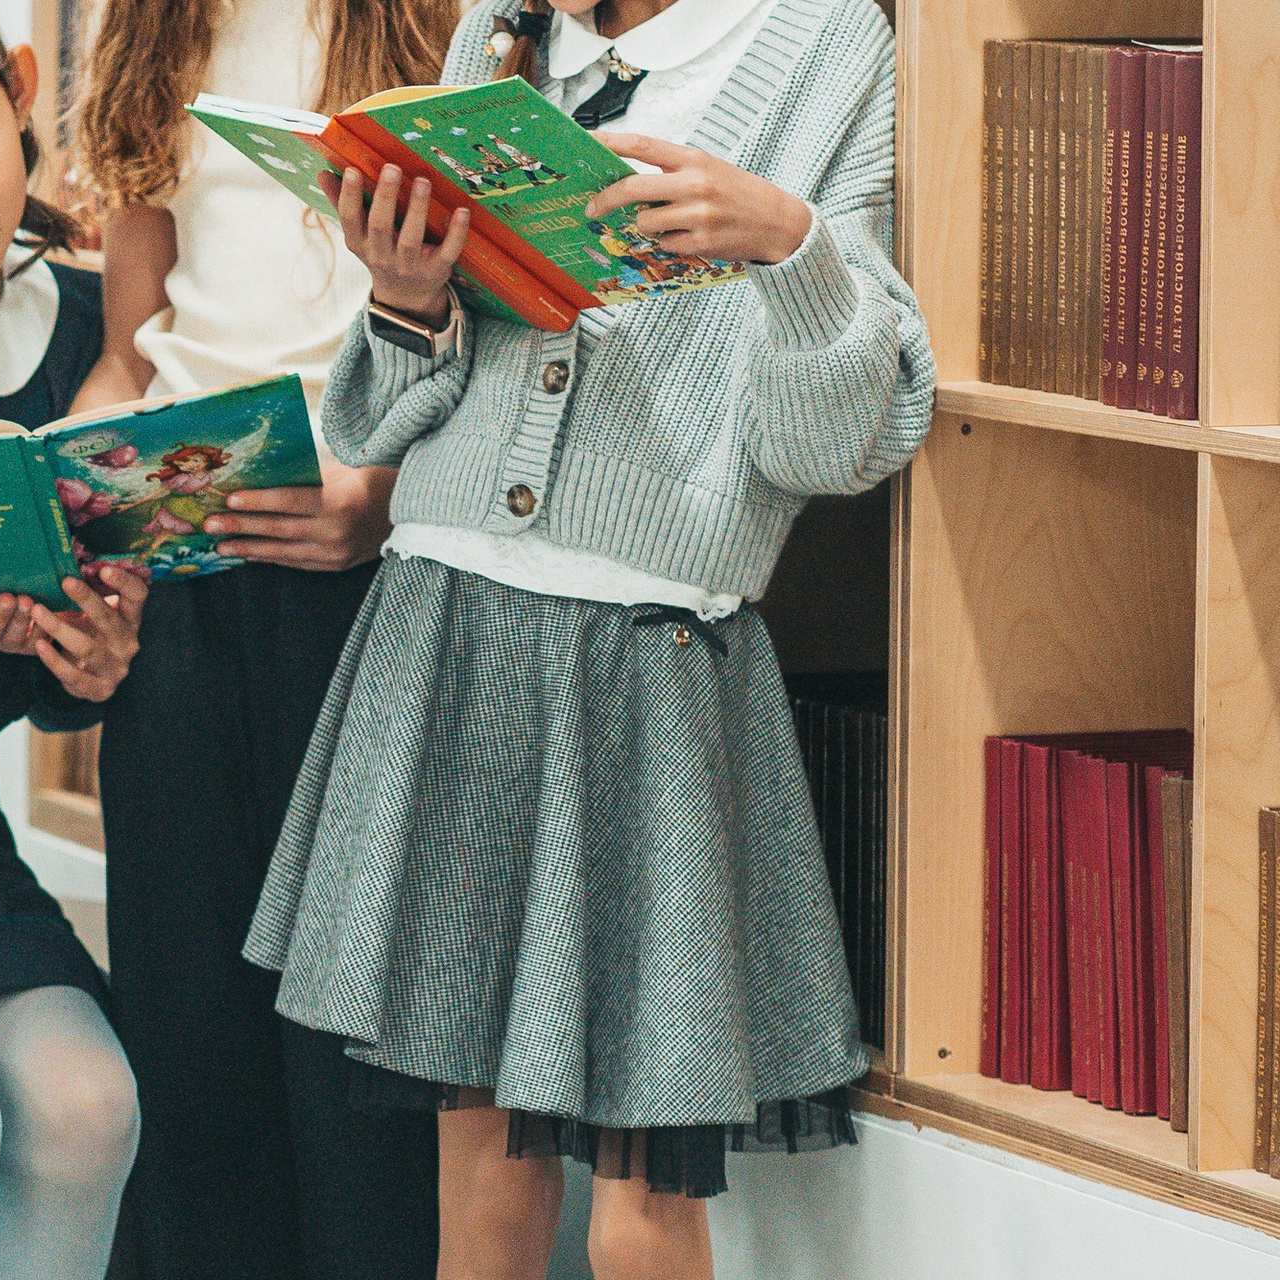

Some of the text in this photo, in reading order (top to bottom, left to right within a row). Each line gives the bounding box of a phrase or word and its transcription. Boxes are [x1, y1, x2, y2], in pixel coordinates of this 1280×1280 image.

[1119, 130, 1130, 236] ВОСКРЕСЕНИЕ
[1142, 131, 1153, 237] ВОСКРЕСЕНИЕ
[1158, 133, 1169, 240] ВОСКРЕСЕНИЕ
[1176, 135, 1187, 243] ВОСКРЕСЕНИЕ
